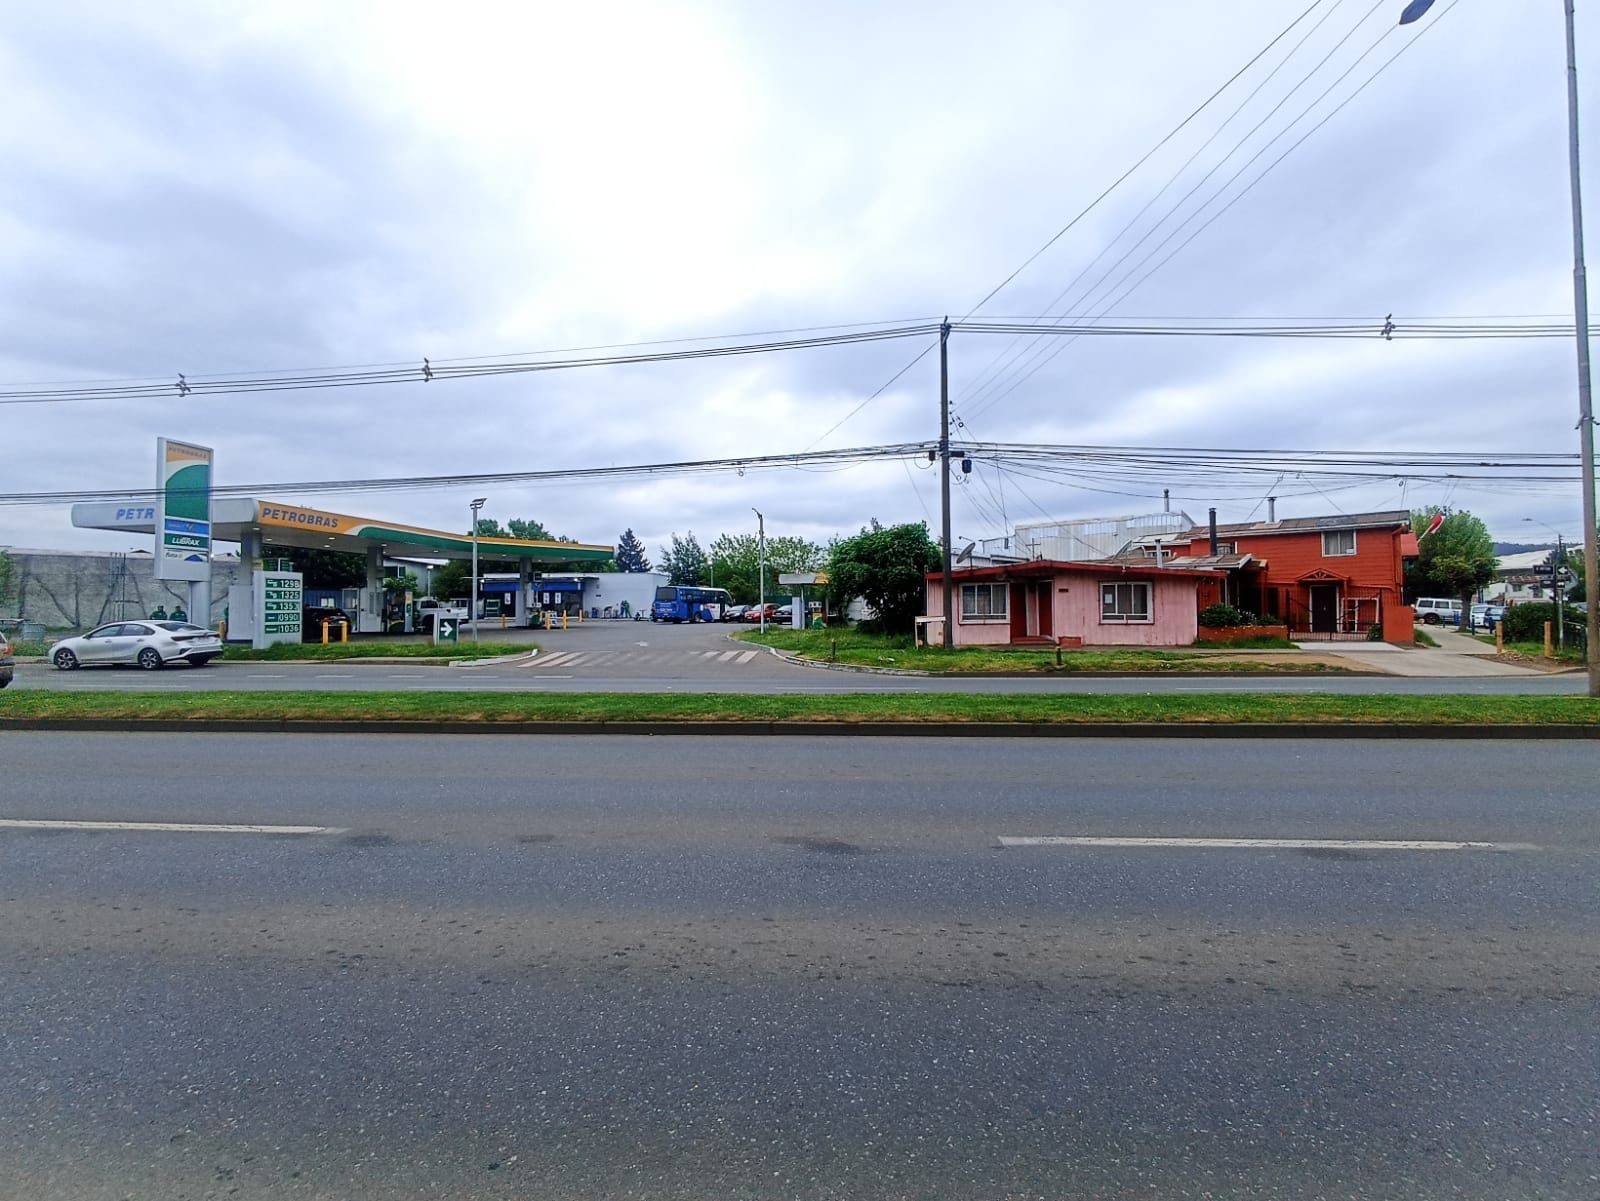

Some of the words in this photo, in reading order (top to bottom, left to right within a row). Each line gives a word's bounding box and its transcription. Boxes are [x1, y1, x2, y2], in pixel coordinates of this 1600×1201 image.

[262, 507, 338, 528] PETROBRAS
[171, 537, 200, 546] LUBRAX
[280, 591, 299, 599] 1325
[280, 625, 299, 633] 1036
